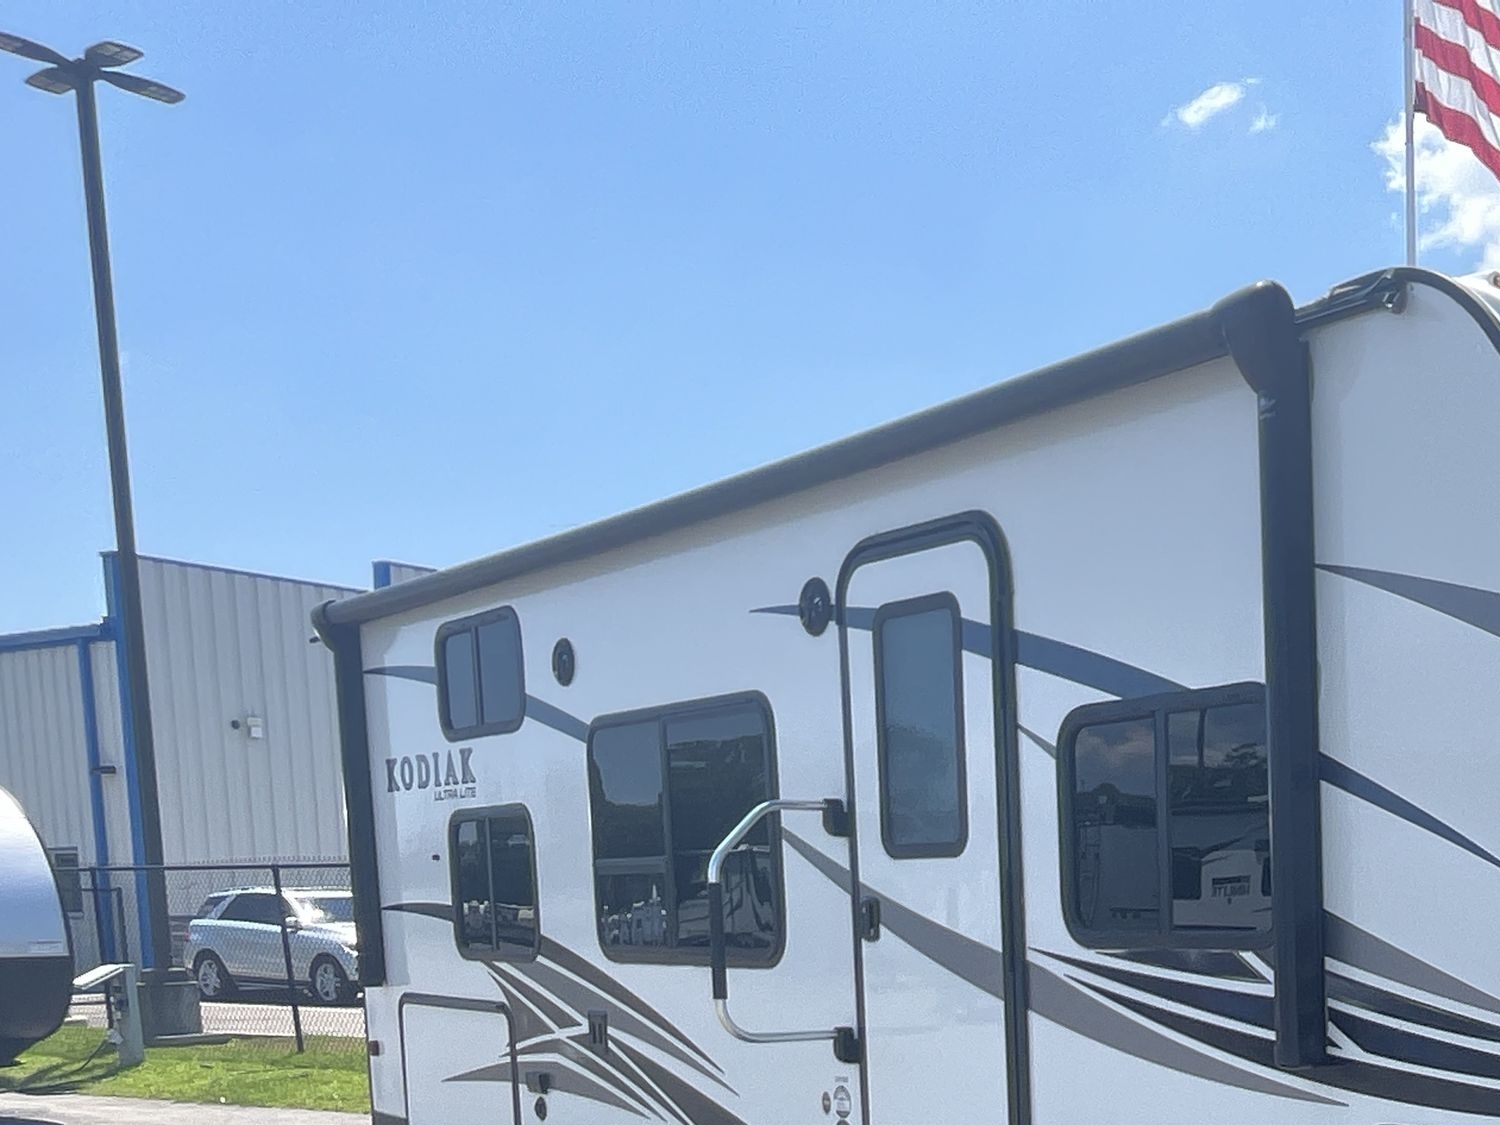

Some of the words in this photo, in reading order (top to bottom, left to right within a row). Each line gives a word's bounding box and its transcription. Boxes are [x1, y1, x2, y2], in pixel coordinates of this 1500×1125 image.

[385, 747, 477, 793] KODIAK
[433, 787, 459, 801] ULTRA
[459, 786, 477, 799] LITE
